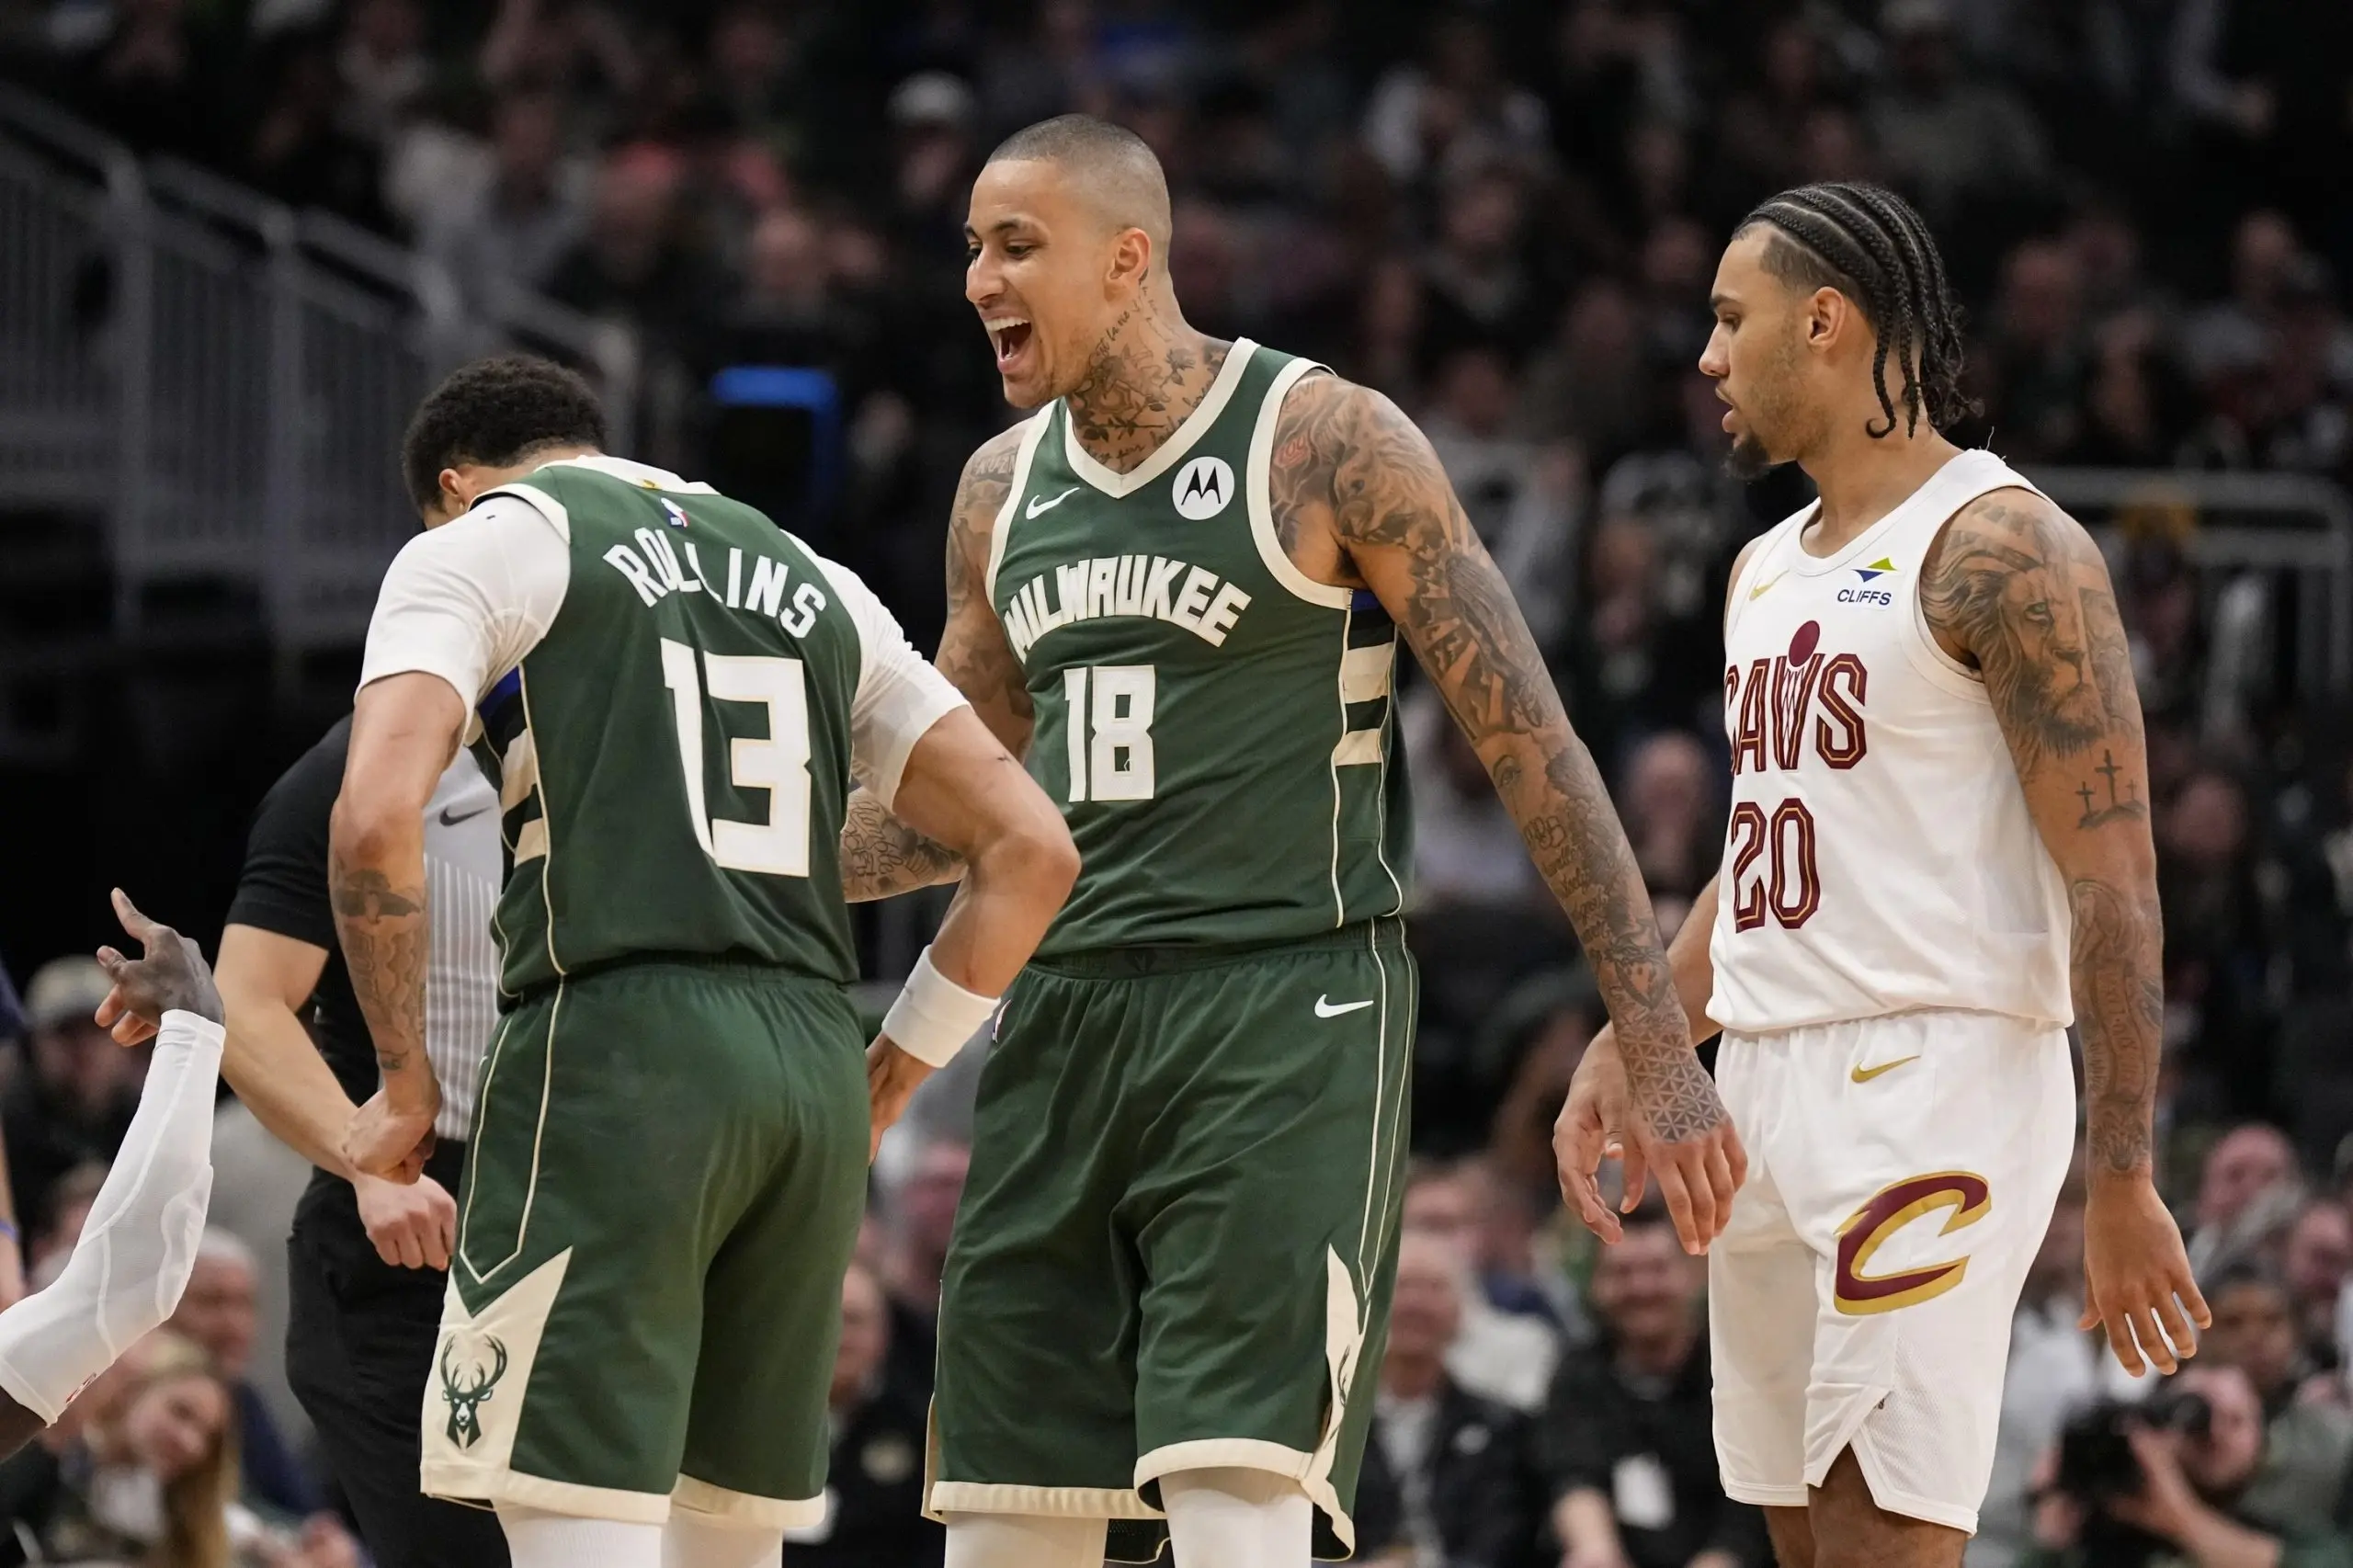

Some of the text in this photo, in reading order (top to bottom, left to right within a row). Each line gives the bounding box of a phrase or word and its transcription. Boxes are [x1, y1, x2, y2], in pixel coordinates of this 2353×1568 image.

[1004, 554, 1252, 665] MILWAUKEE
[1836, 588, 1893, 606] CLIFFS
[659, 637, 812, 878] 13
[1063, 665, 1156, 802] 18
[1723, 652, 1869, 777] CAVS
[1731, 797, 1821, 934] 20
[1833, 1170, 1992, 1316] C
